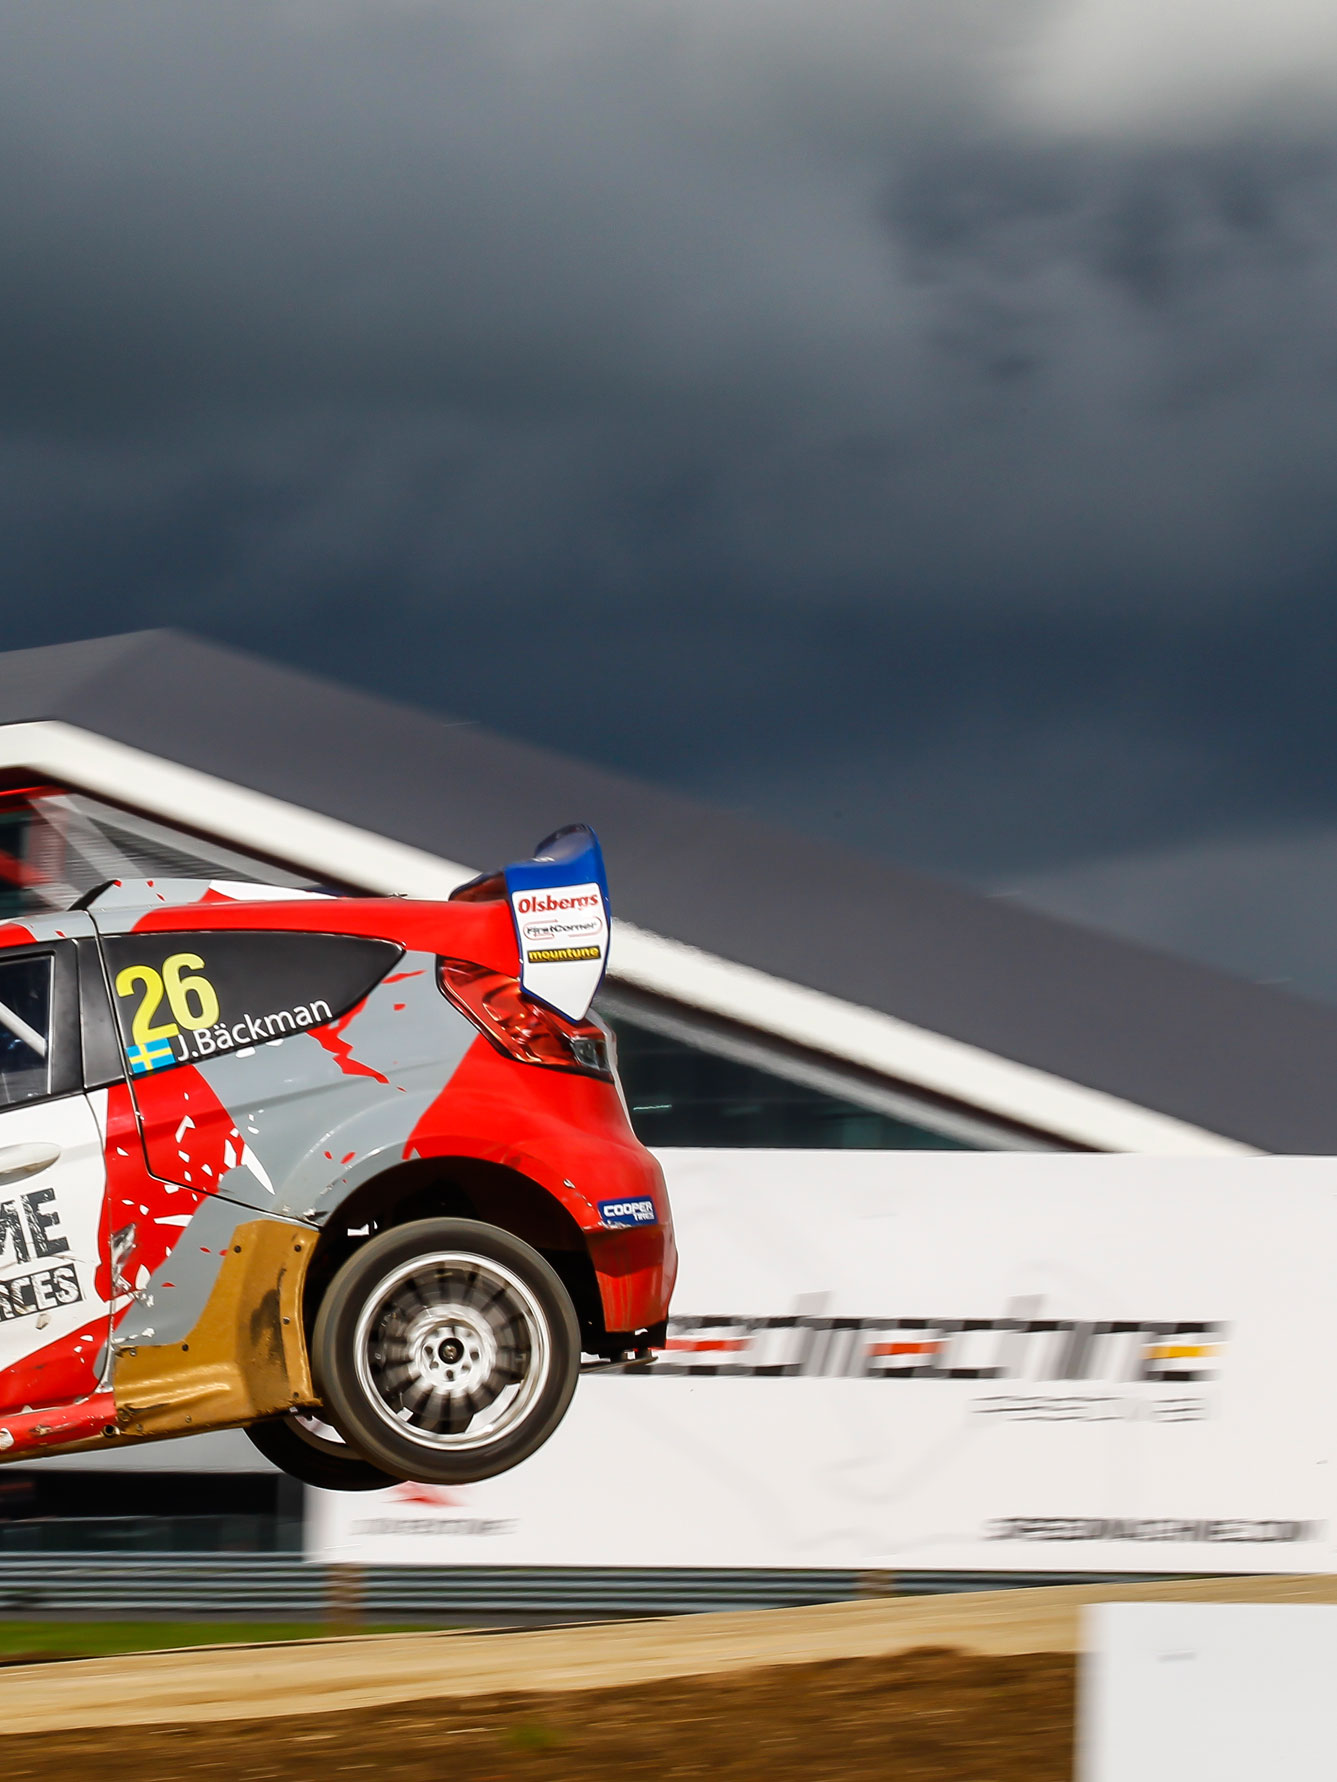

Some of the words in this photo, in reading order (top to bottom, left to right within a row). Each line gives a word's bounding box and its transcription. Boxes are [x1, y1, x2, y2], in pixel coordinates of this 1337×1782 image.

[528, 946, 599, 961] mountune
[115, 952, 220, 1046] 26
[603, 1201, 654, 1217] COOPER
